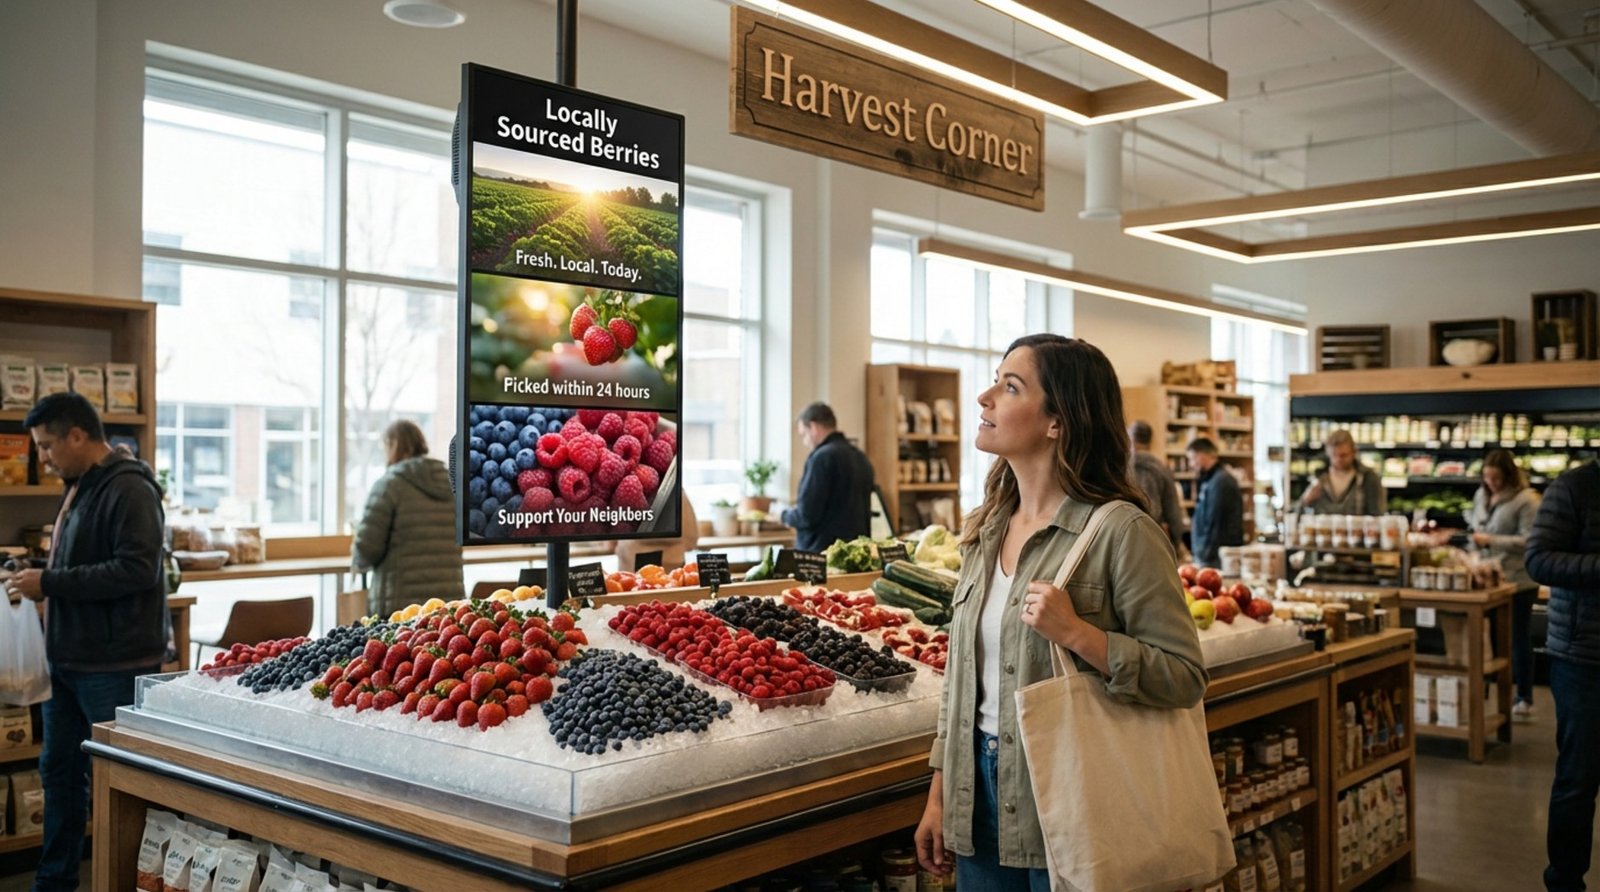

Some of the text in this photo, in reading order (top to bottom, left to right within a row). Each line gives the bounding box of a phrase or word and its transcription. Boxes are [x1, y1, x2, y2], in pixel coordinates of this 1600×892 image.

[546, 98, 618, 137] Locally
[761, 48, 1033, 175] Harvest Corner
[497, 116, 660, 169] Sourced Berries
[515, 250, 642, 281] Fresh. Local. Today.
[504, 377, 650, 399] Picked within 24 hours
[498, 508, 553, 529] Support
[556, 508, 586, 524] Your
